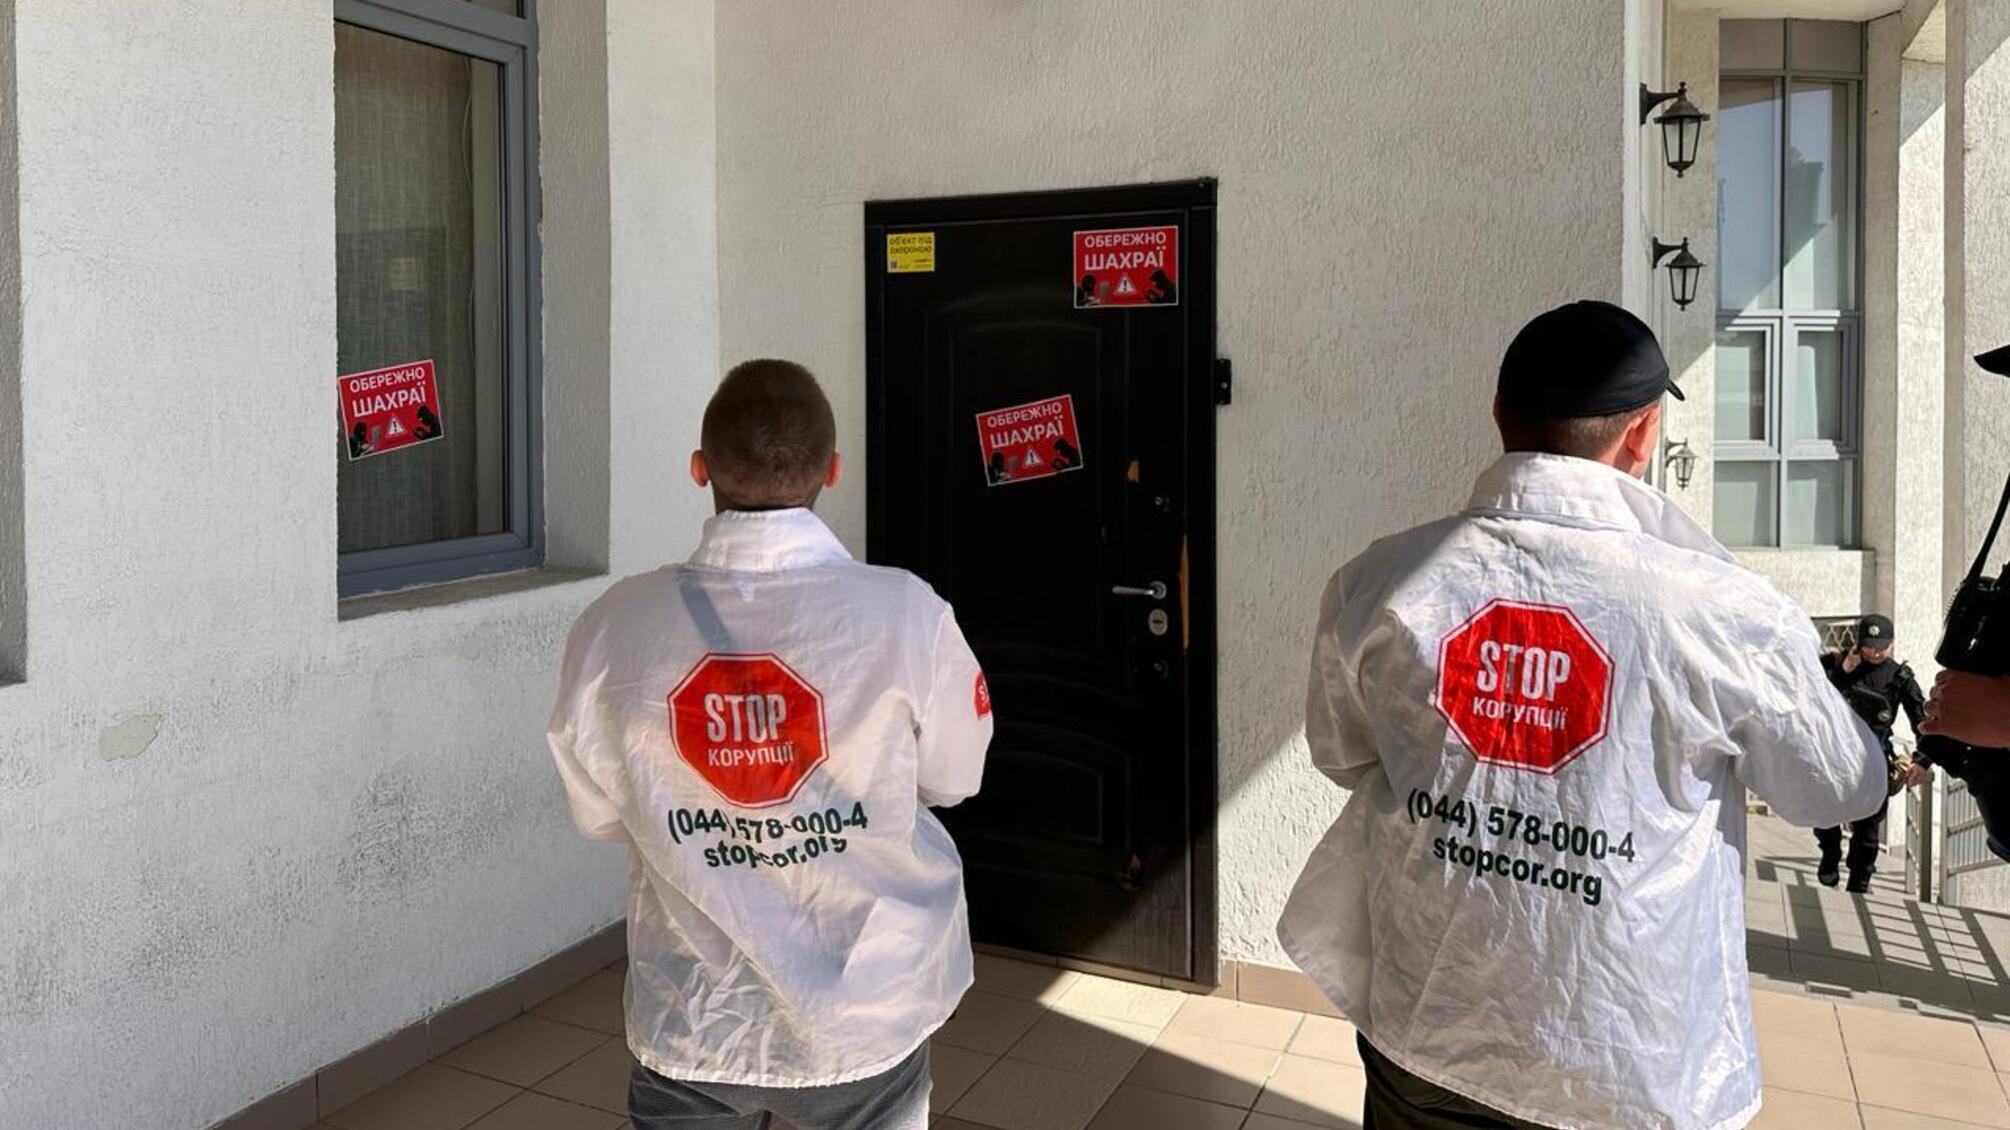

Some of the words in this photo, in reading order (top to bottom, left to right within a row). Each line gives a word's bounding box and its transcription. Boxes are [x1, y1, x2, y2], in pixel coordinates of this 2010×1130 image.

[1084, 231, 1166, 248] ОБЕРЕЖНО
[1084, 245, 1166, 271] ШАХРАЇ
[349, 367, 425, 393] ОБЕРЕЖНО
[352, 381, 426, 418] ШАХРАЇ
[987, 402, 1062, 428] ОБЕРЕЖНО
[990, 415, 1064, 449] ШАХРАЇ
[1476, 640, 1571, 702] STOP
[704, 692, 787, 744] STOP
[1472, 697, 1568, 731] КОРУПЦІЇ
[708, 741, 795, 767] КОРУПЦІЇ
[735, 801, 868, 843] 578-000-4
[1407, 788, 1477, 838] (044)
[1487, 806, 1636, 863] 578-000-4
[1432, 835, 1602, 906] stopcor.org
